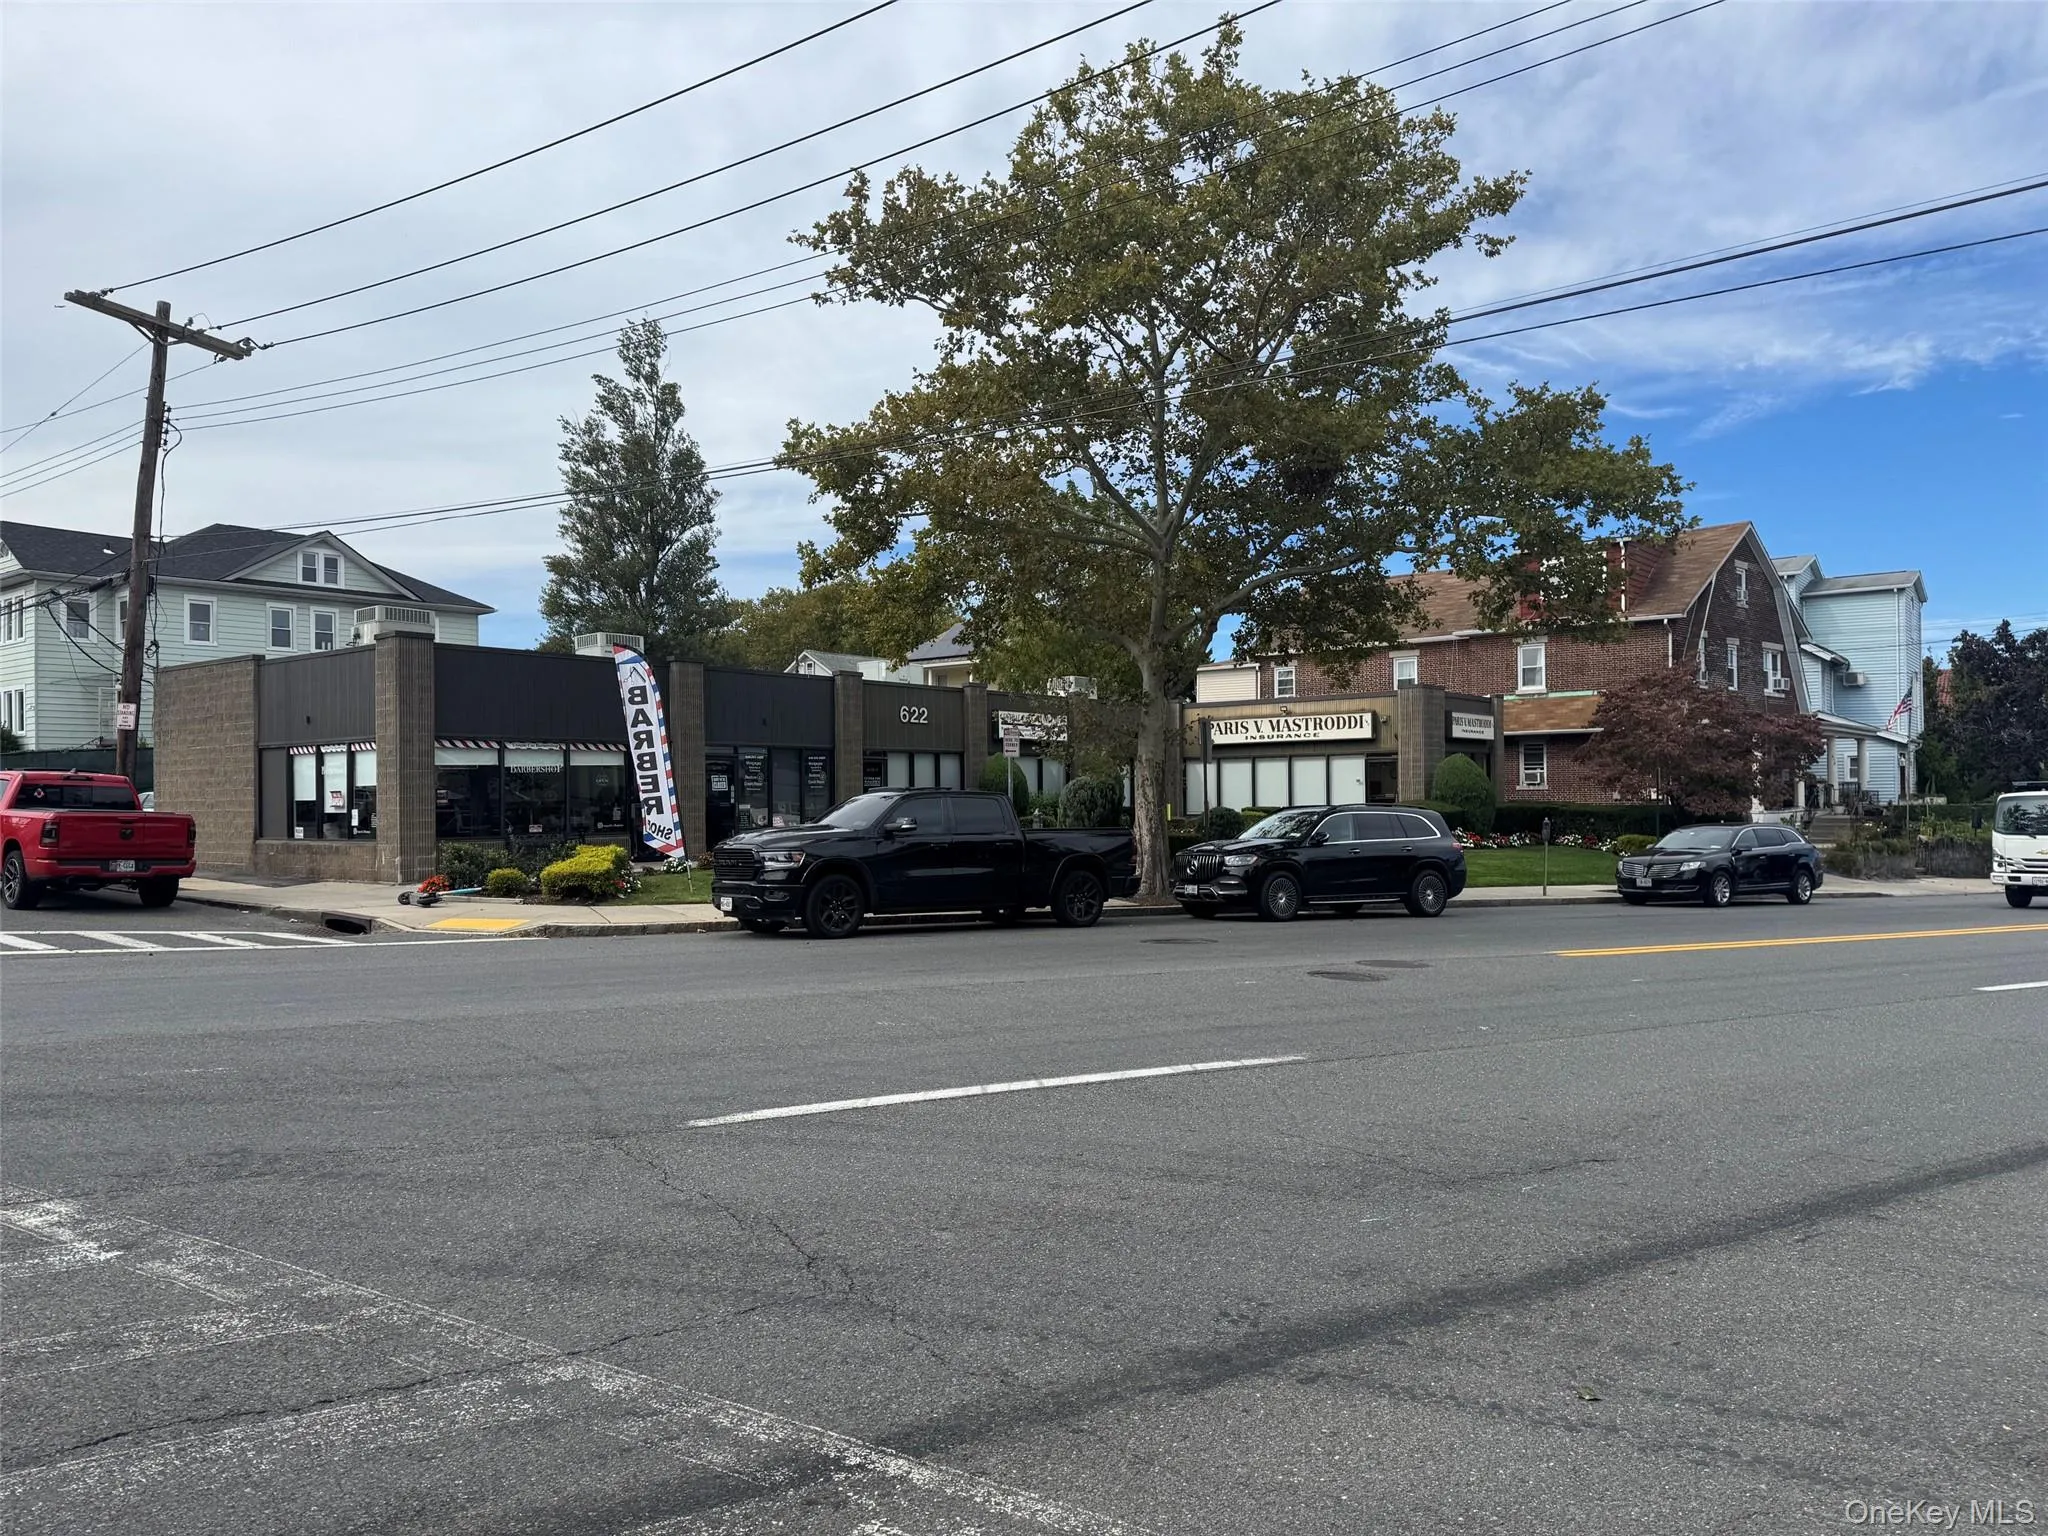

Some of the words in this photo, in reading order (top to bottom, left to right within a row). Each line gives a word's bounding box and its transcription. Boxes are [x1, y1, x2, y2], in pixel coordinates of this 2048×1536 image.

[900, 705, 928, 724] 622
[1211, 720, 1249, 735] PARIS
[1253, 719, 1264, 733] V.
[1268, 714, 1365, 733] MASTRODDI
[1245, 732, 1320, 740] INSURANCE
